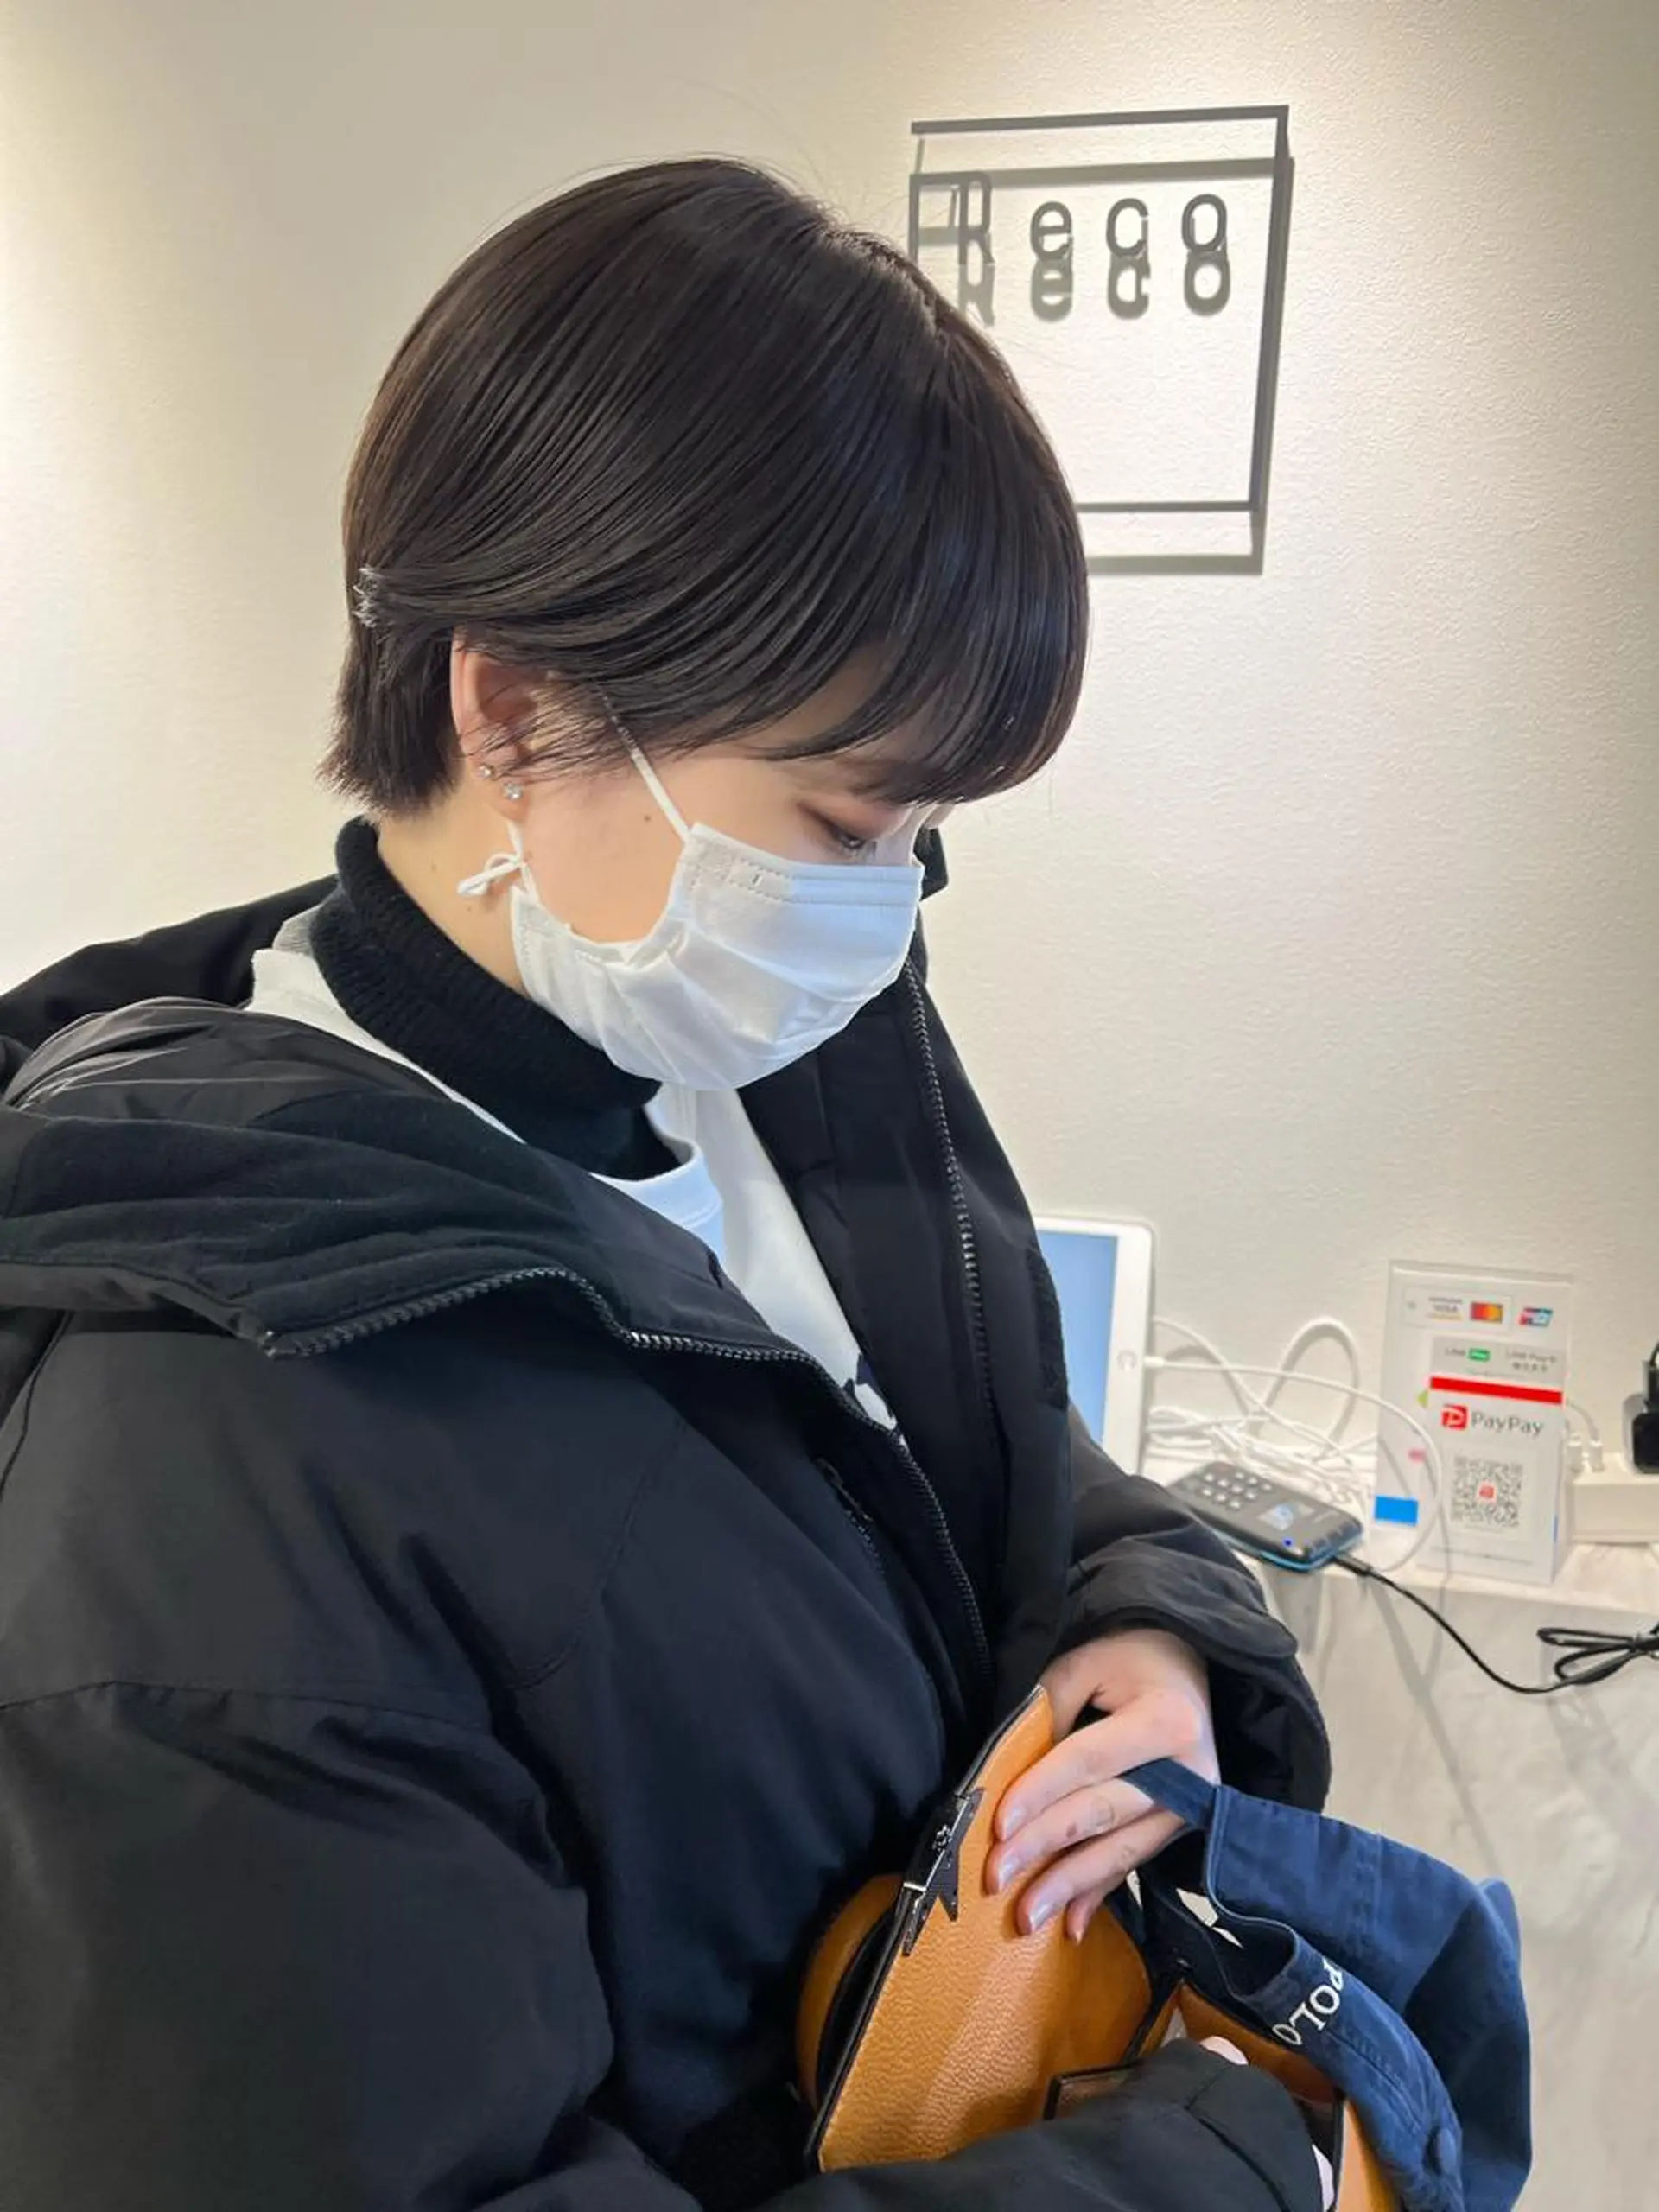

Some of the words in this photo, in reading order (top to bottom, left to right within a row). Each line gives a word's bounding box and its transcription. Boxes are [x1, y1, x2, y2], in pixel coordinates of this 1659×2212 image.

[958, 171, 1229, 264] Reco
[1471, 1410, 1544, 1439] PayPay
[1271, 1956, 1344, 2046] POLO
